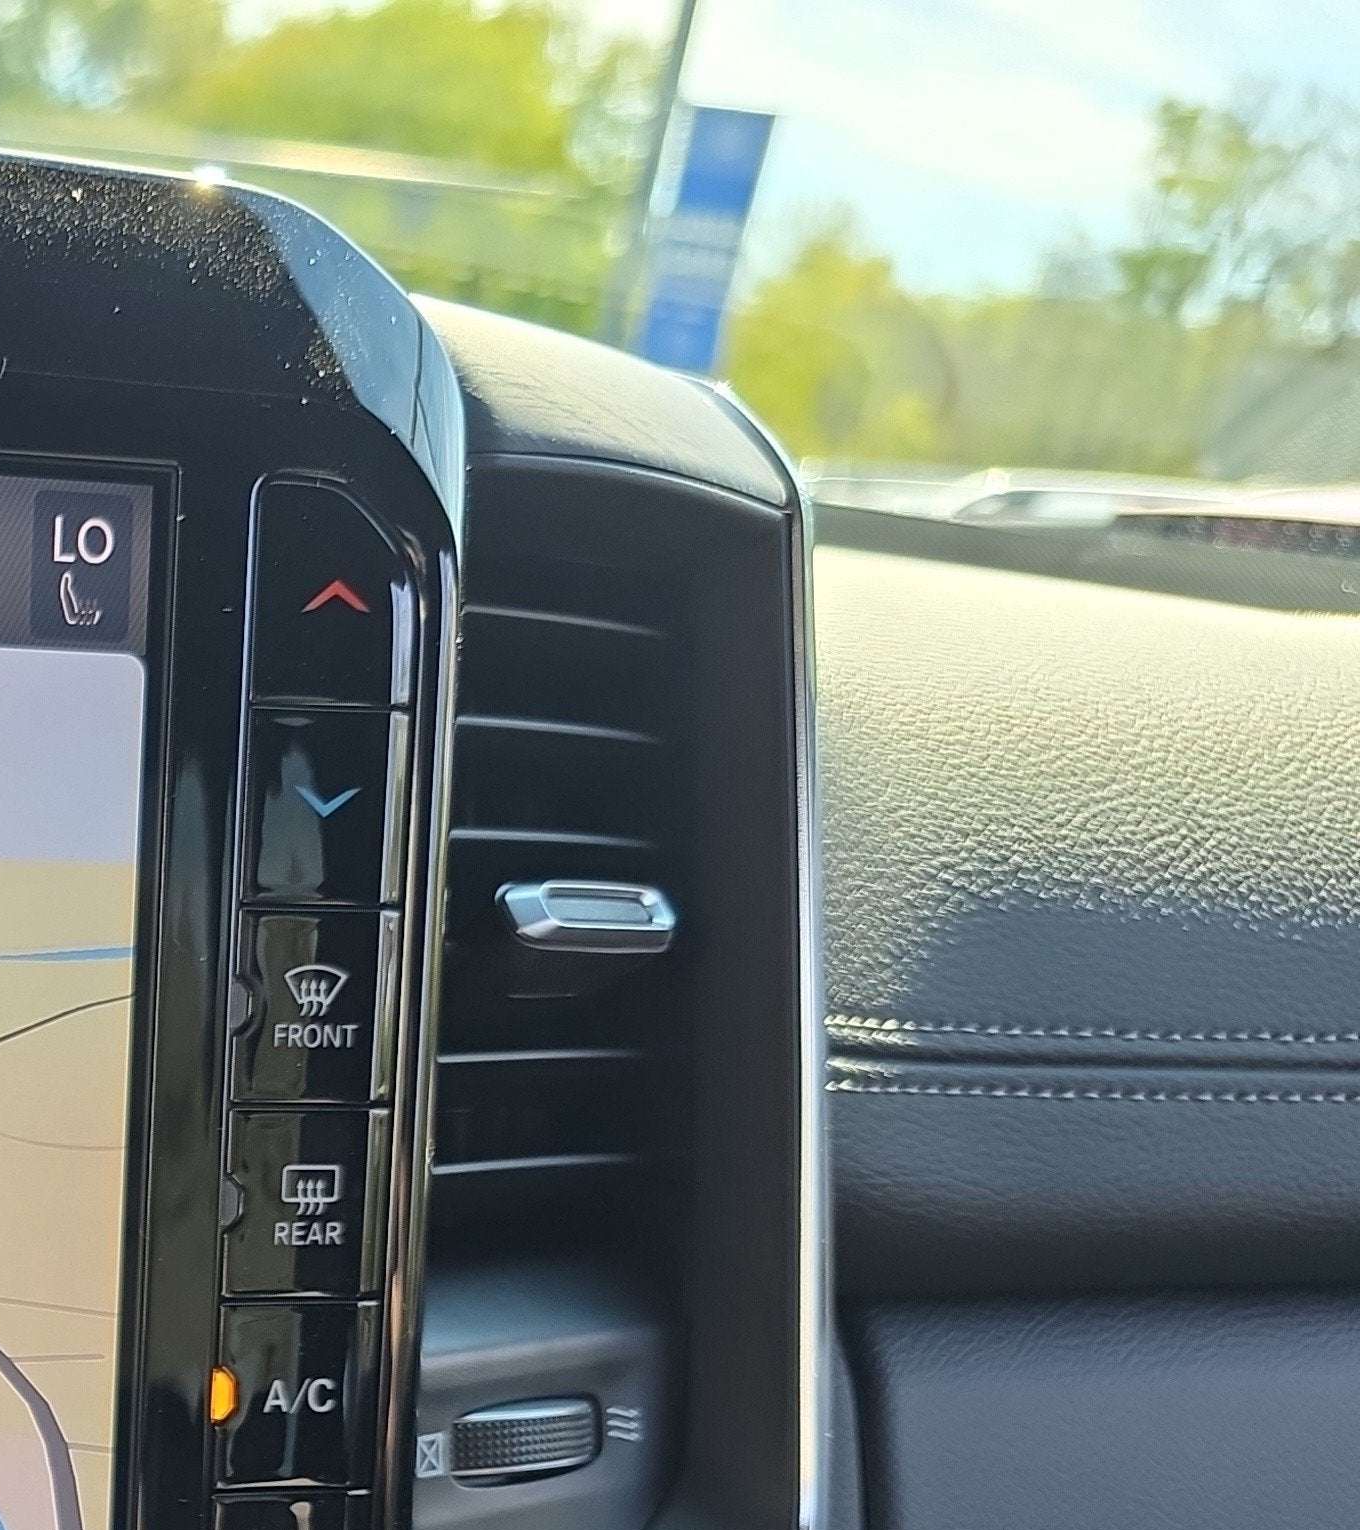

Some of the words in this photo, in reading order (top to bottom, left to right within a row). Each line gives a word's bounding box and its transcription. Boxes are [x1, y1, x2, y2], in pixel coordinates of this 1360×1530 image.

[53, 514, 116, 566] LO
[273, 1023, 361, 1049] FRONT
[273, 1222, 345, 1247] REAR
[262, 1377, 337, 1415] A/C
